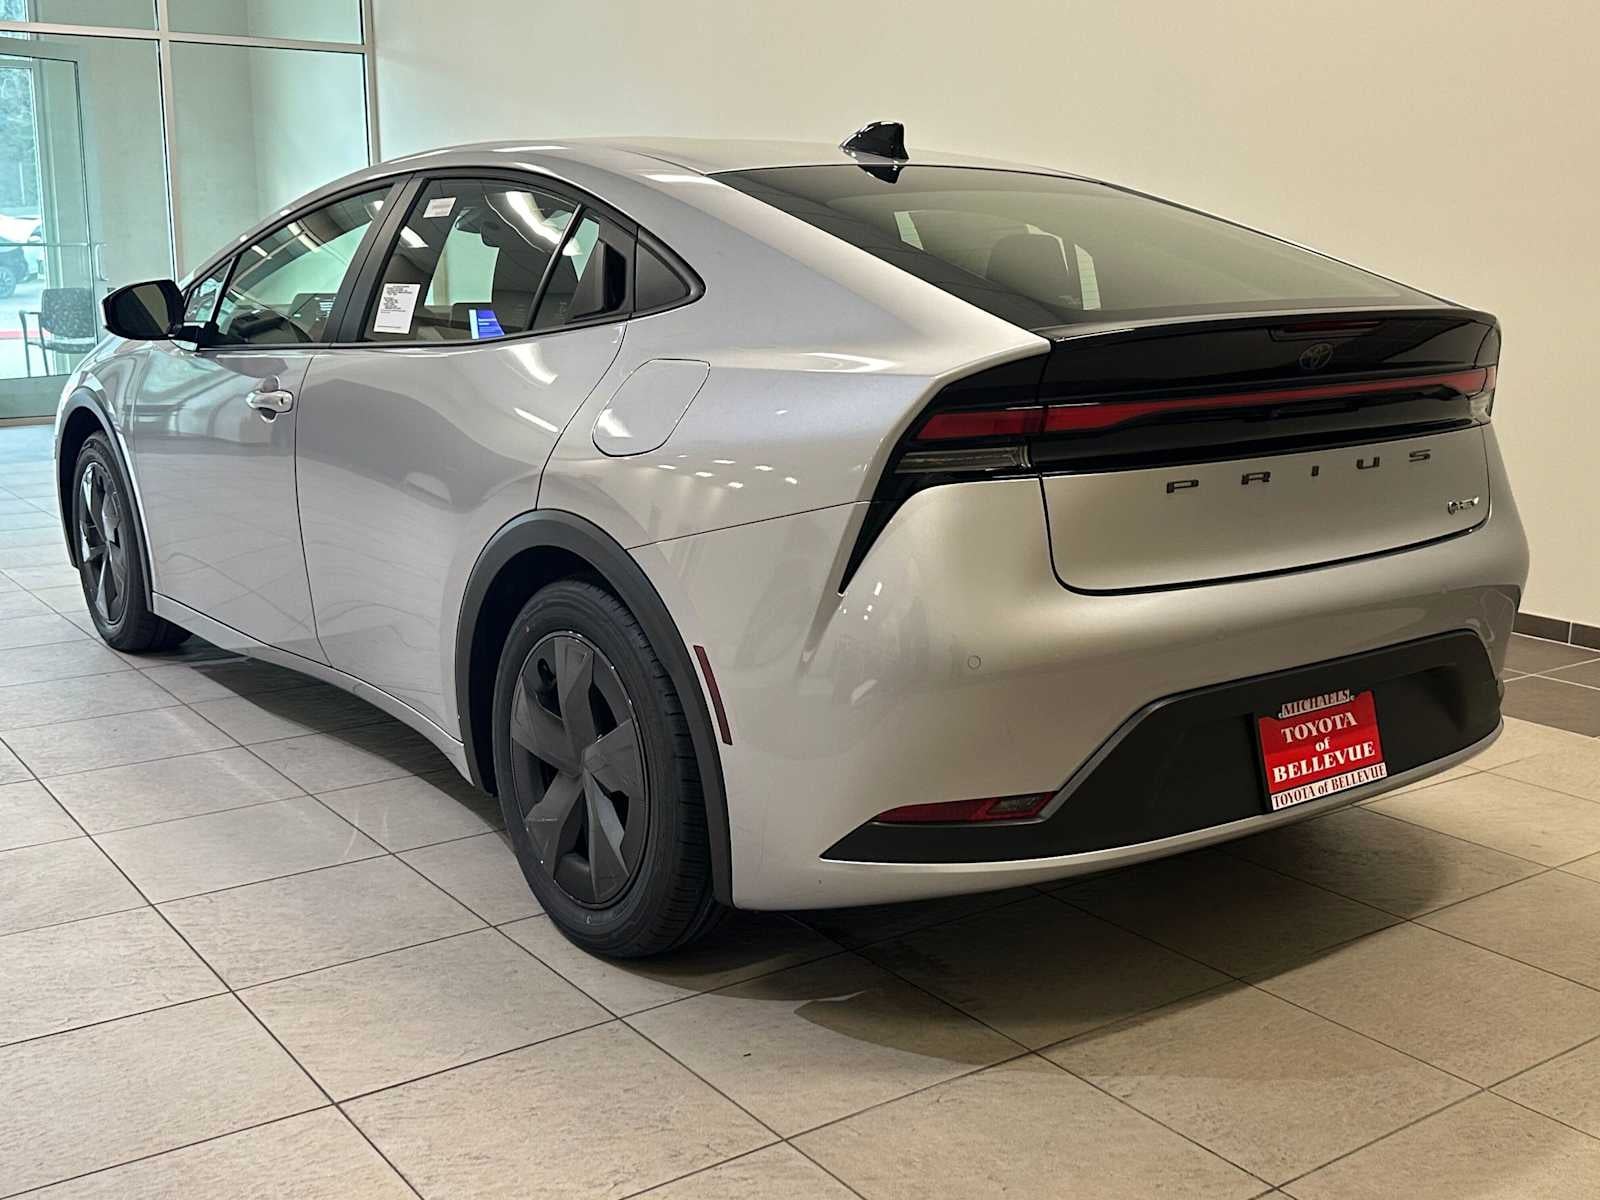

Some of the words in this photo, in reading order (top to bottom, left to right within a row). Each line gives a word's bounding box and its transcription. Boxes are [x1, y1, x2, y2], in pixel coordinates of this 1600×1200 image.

[1166, 449, 1431, 493] PRIUS
[1281, 712, 1358, 743] TOYOTA
[1315, 736, 1331, 752] of
[1272, 741, 1375, 783] BELLEVUE
[1273, 788, 1316, 809] TOYOTA
[1317, 783, 1329, 795] of
[1331, 763, 1386, 790] BELLEVUE
